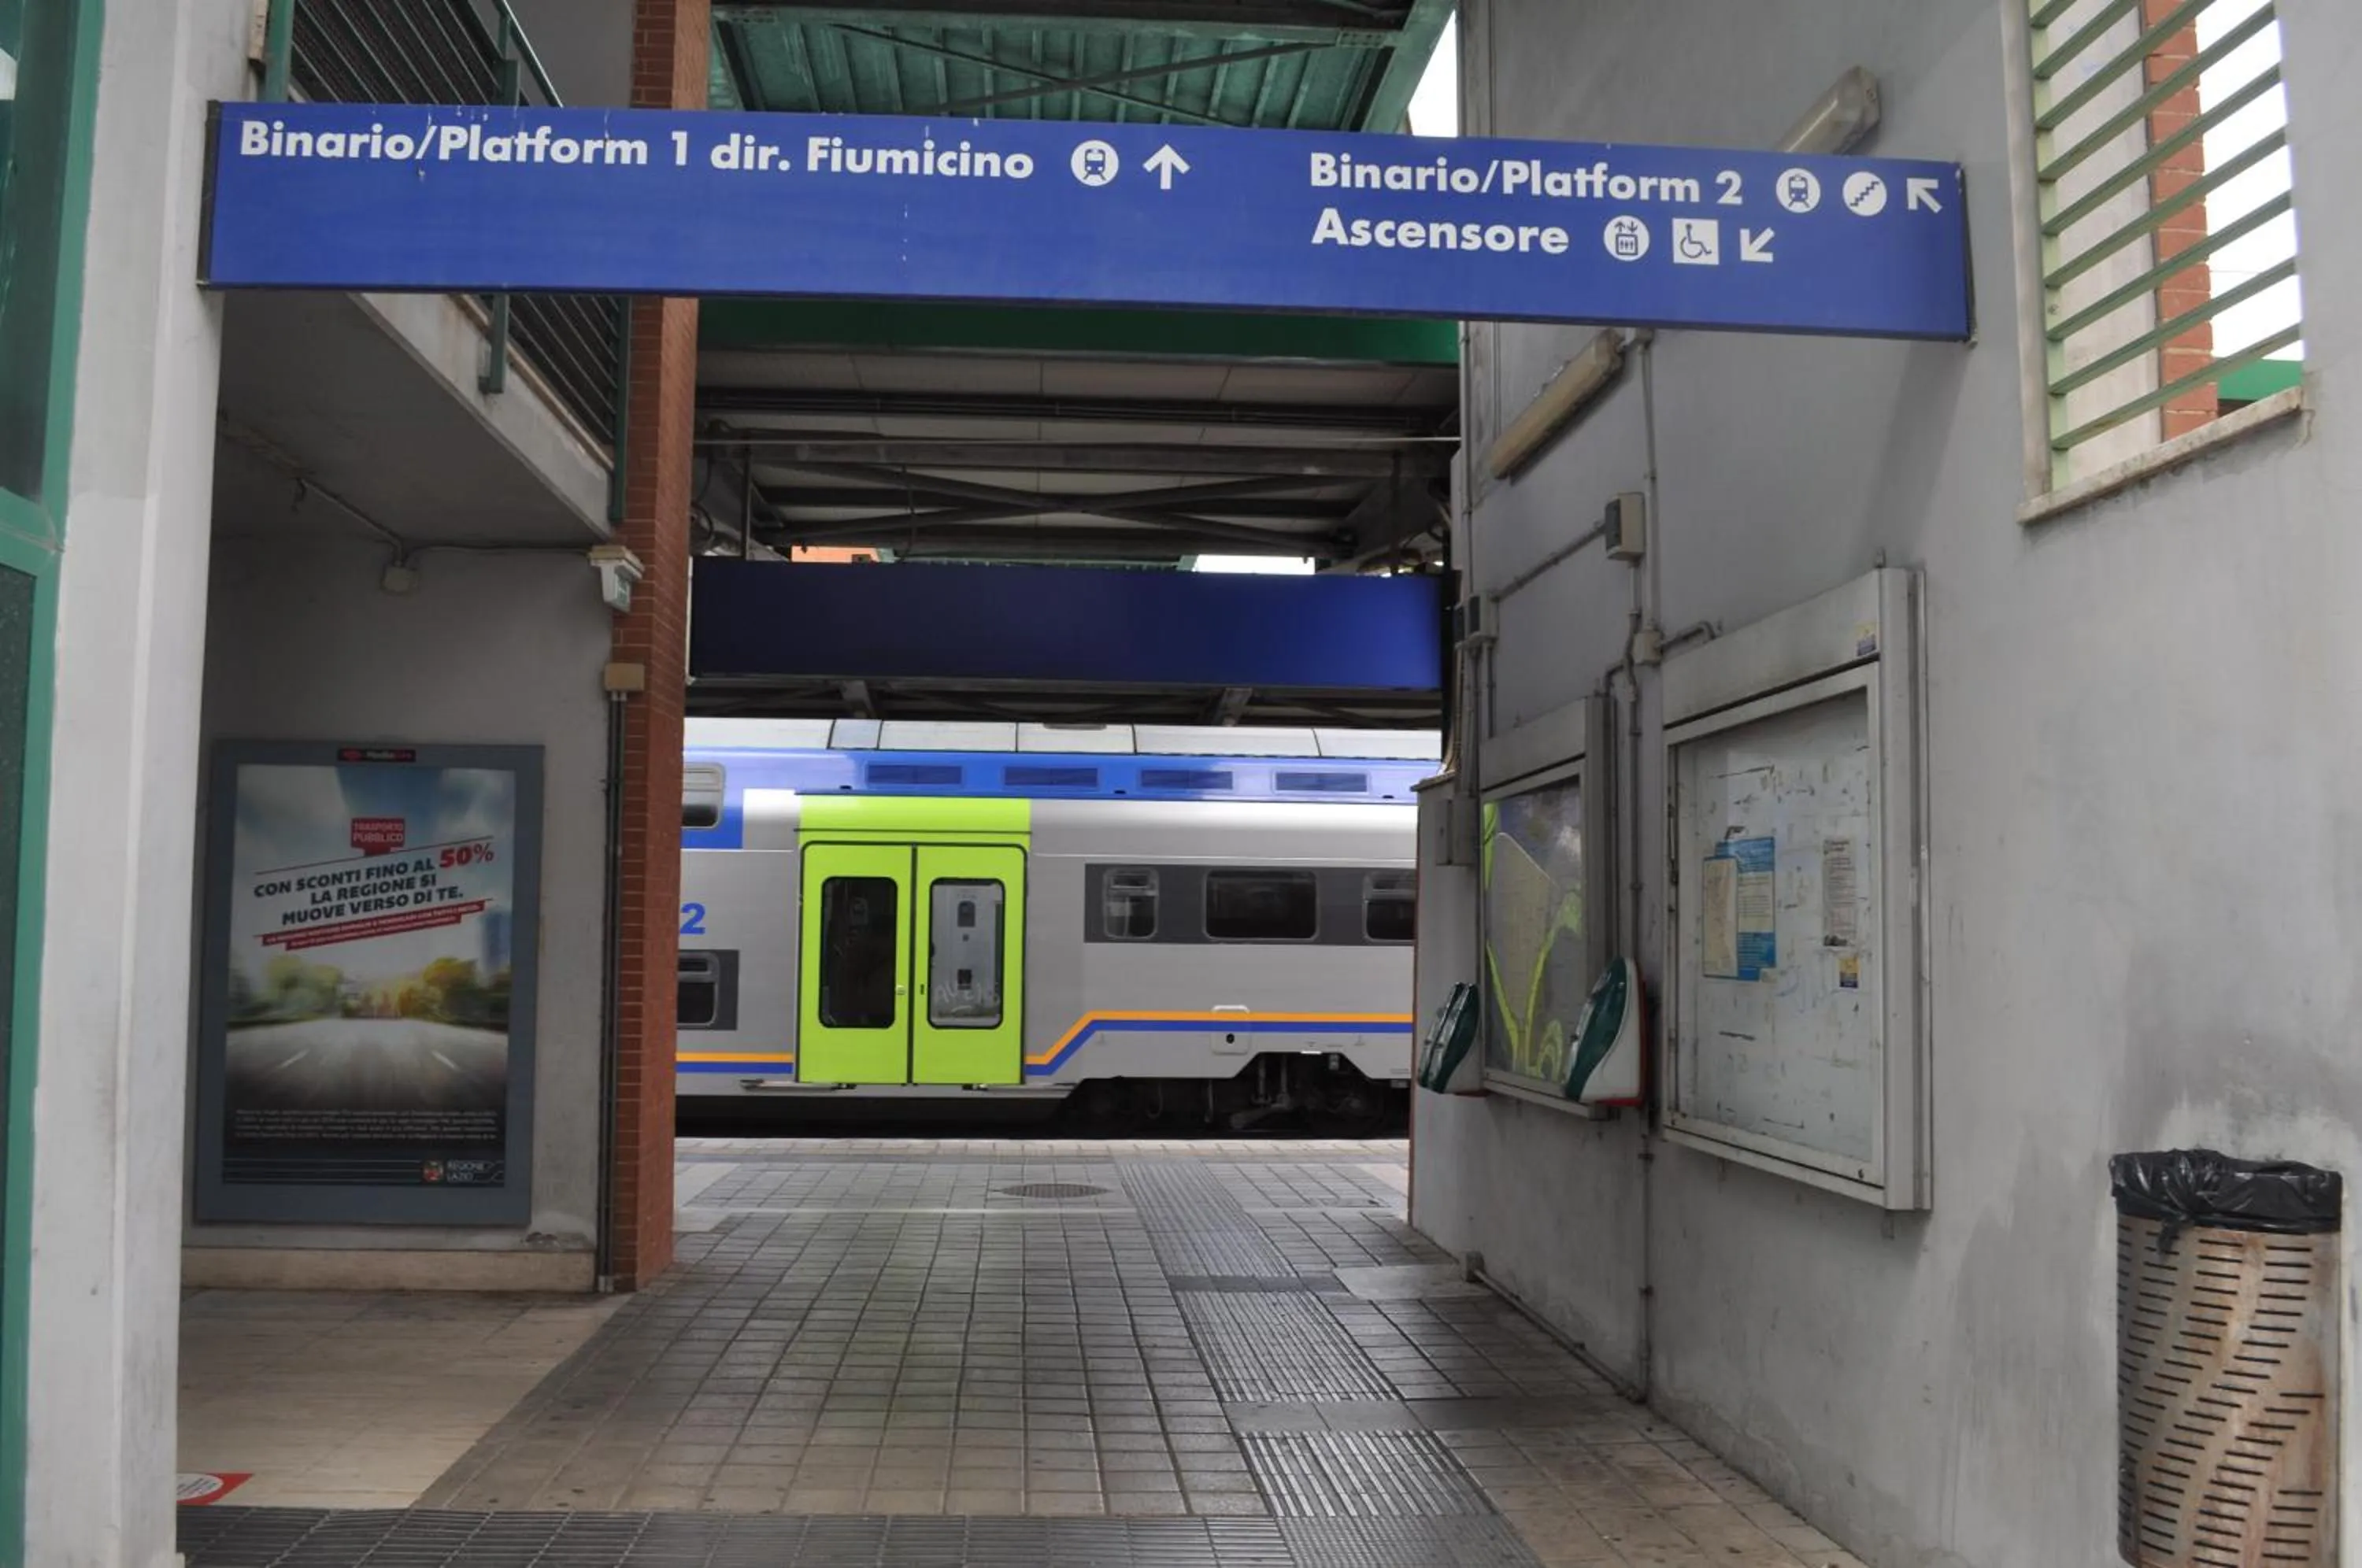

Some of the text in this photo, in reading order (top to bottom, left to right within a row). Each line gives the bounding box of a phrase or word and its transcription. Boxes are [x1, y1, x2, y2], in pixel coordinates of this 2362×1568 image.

[240, 120, 1035, 179] Binario/Platform 1 dir. Fiumicino
[1310, 152, 1743, 205] Binario/Platform 2
[1311, 208, 1569, 254] Ascensore
[353, 833, 403, 843] PUBBLICO
[254, 844, 494, 898] CON SCONTI FINO AL 50%
[310, 874, 437, 906] LA REGIONE SI
[281, 904, 346, 926] MUOVE
[350, 894, 413, 915] VERSO
[413, 889, 433, 904] DI
[436, 886, 464, 900] TE.
[680, 903, 705, 934] 2
